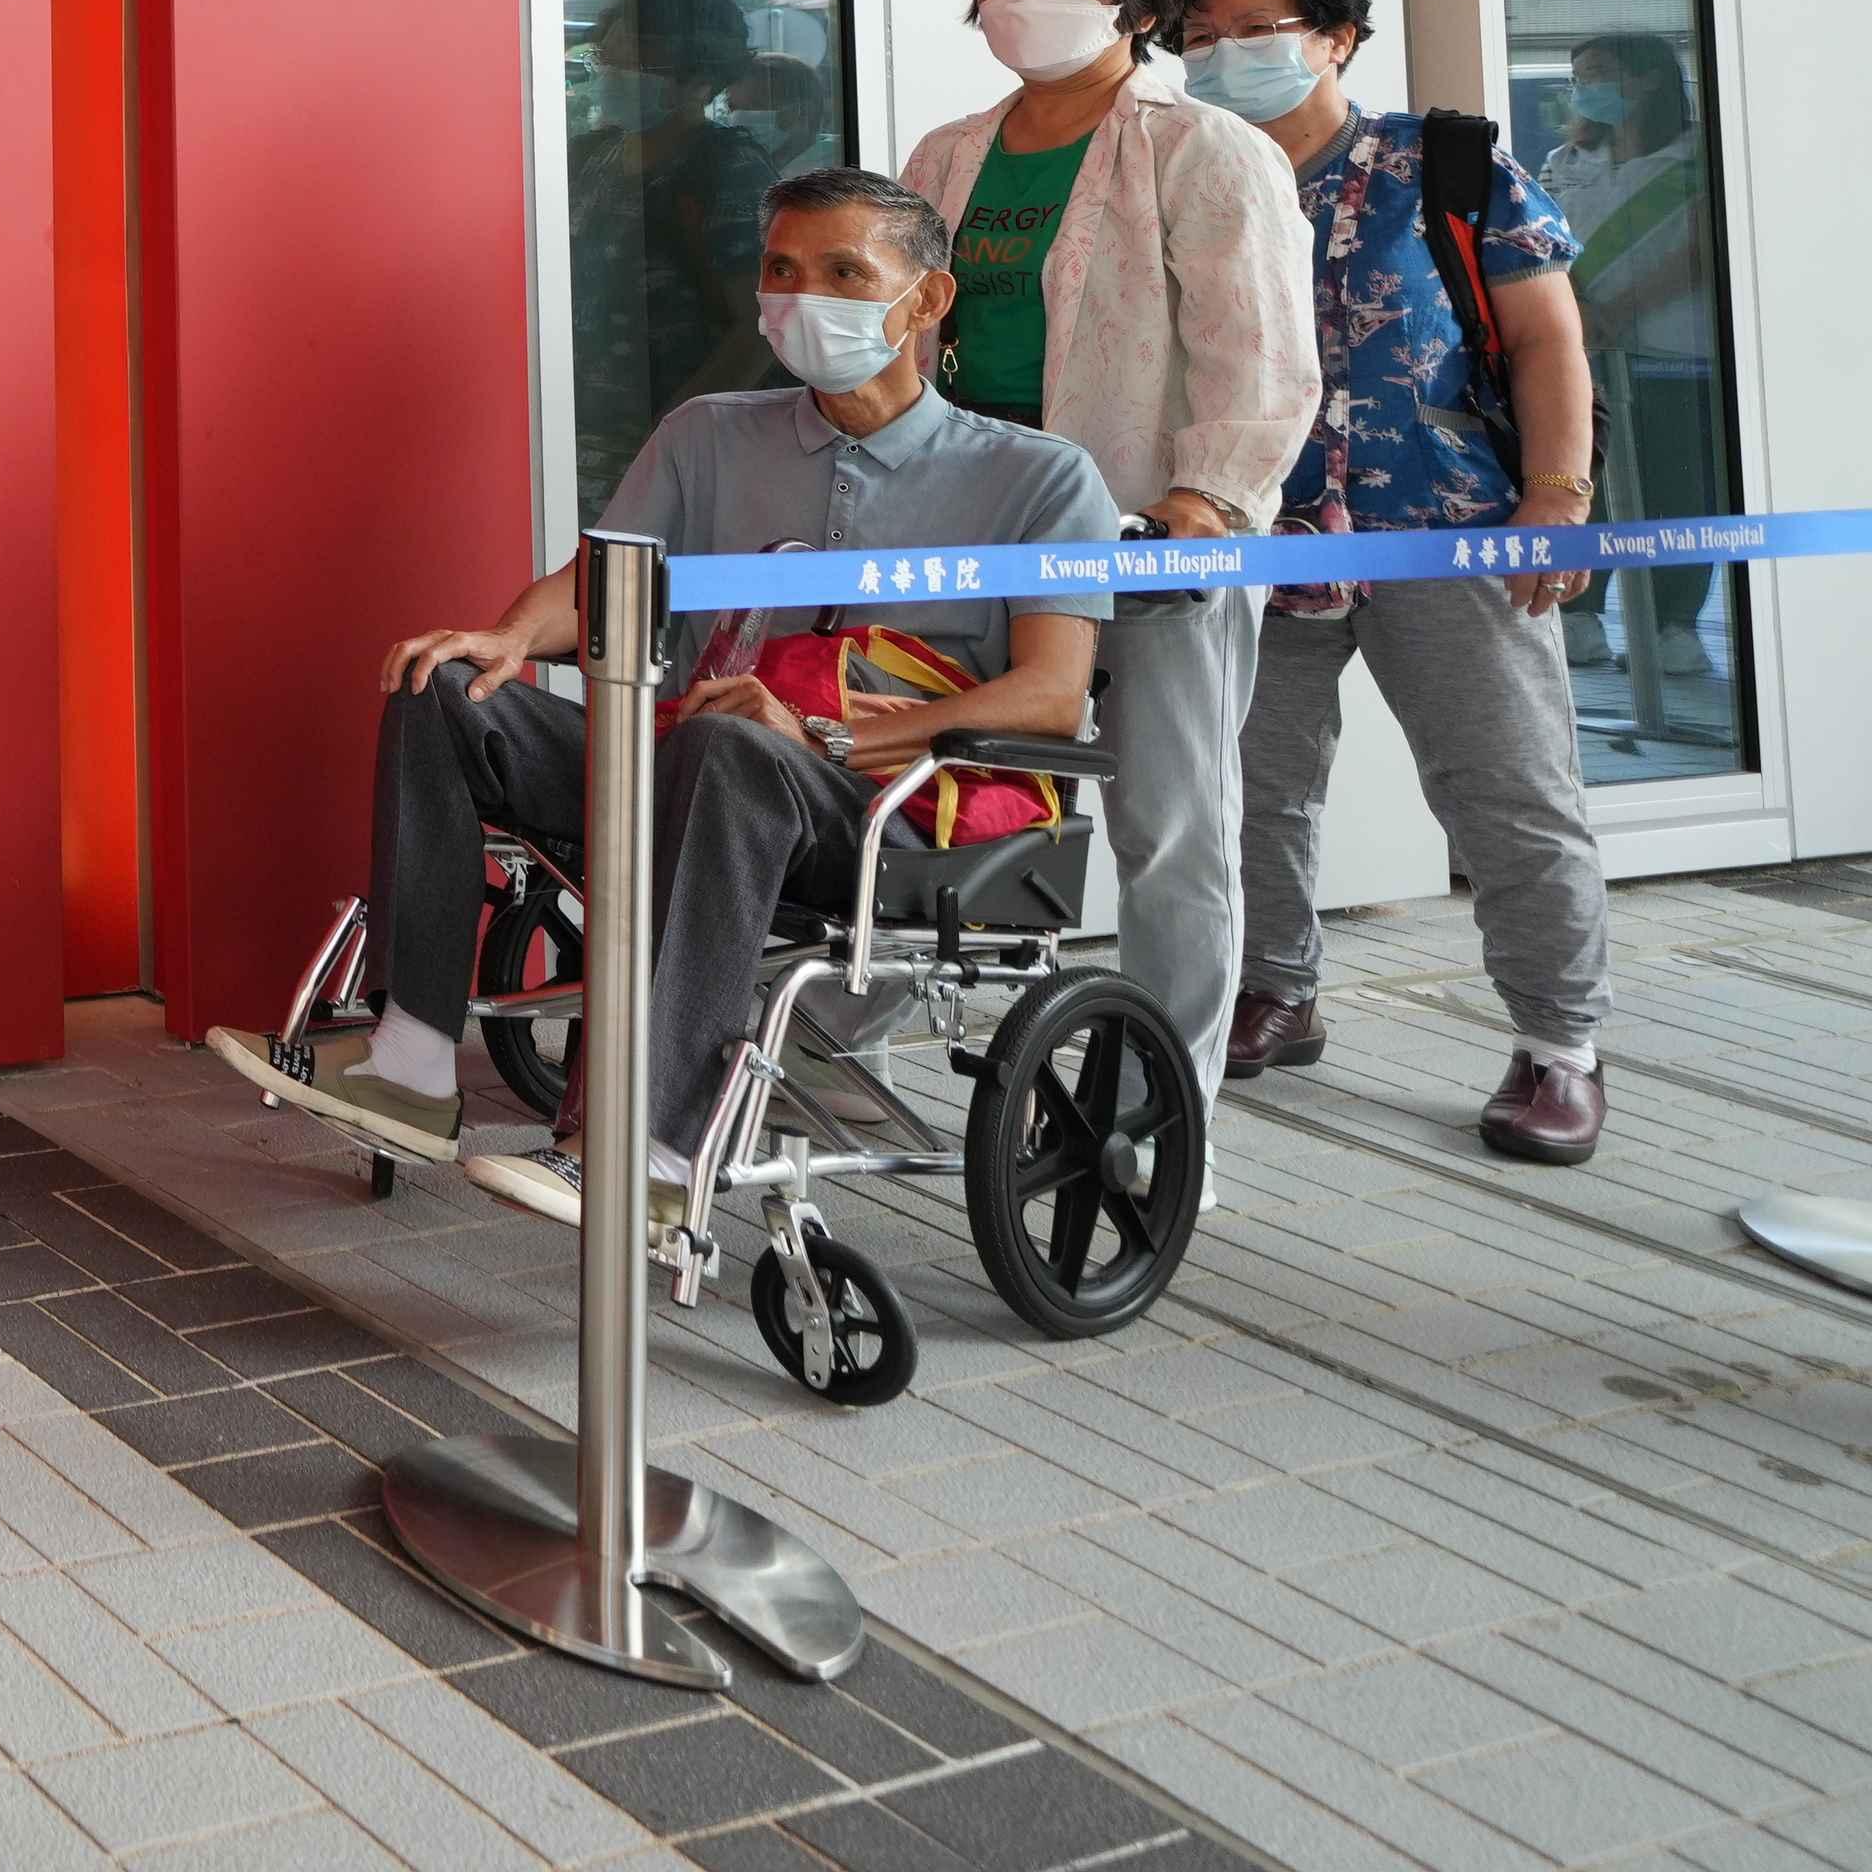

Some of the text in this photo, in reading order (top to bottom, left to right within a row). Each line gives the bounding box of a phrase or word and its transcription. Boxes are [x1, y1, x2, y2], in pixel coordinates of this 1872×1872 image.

[1452, 535, 1553, 569] 廣華醫院
[1599, 523, 1764, 558] Kwong Wah Hospital
[858, 556, 980, 594] 廣華醫院
[1039, 547, 1242, 583] Kwong Wah Hospital
